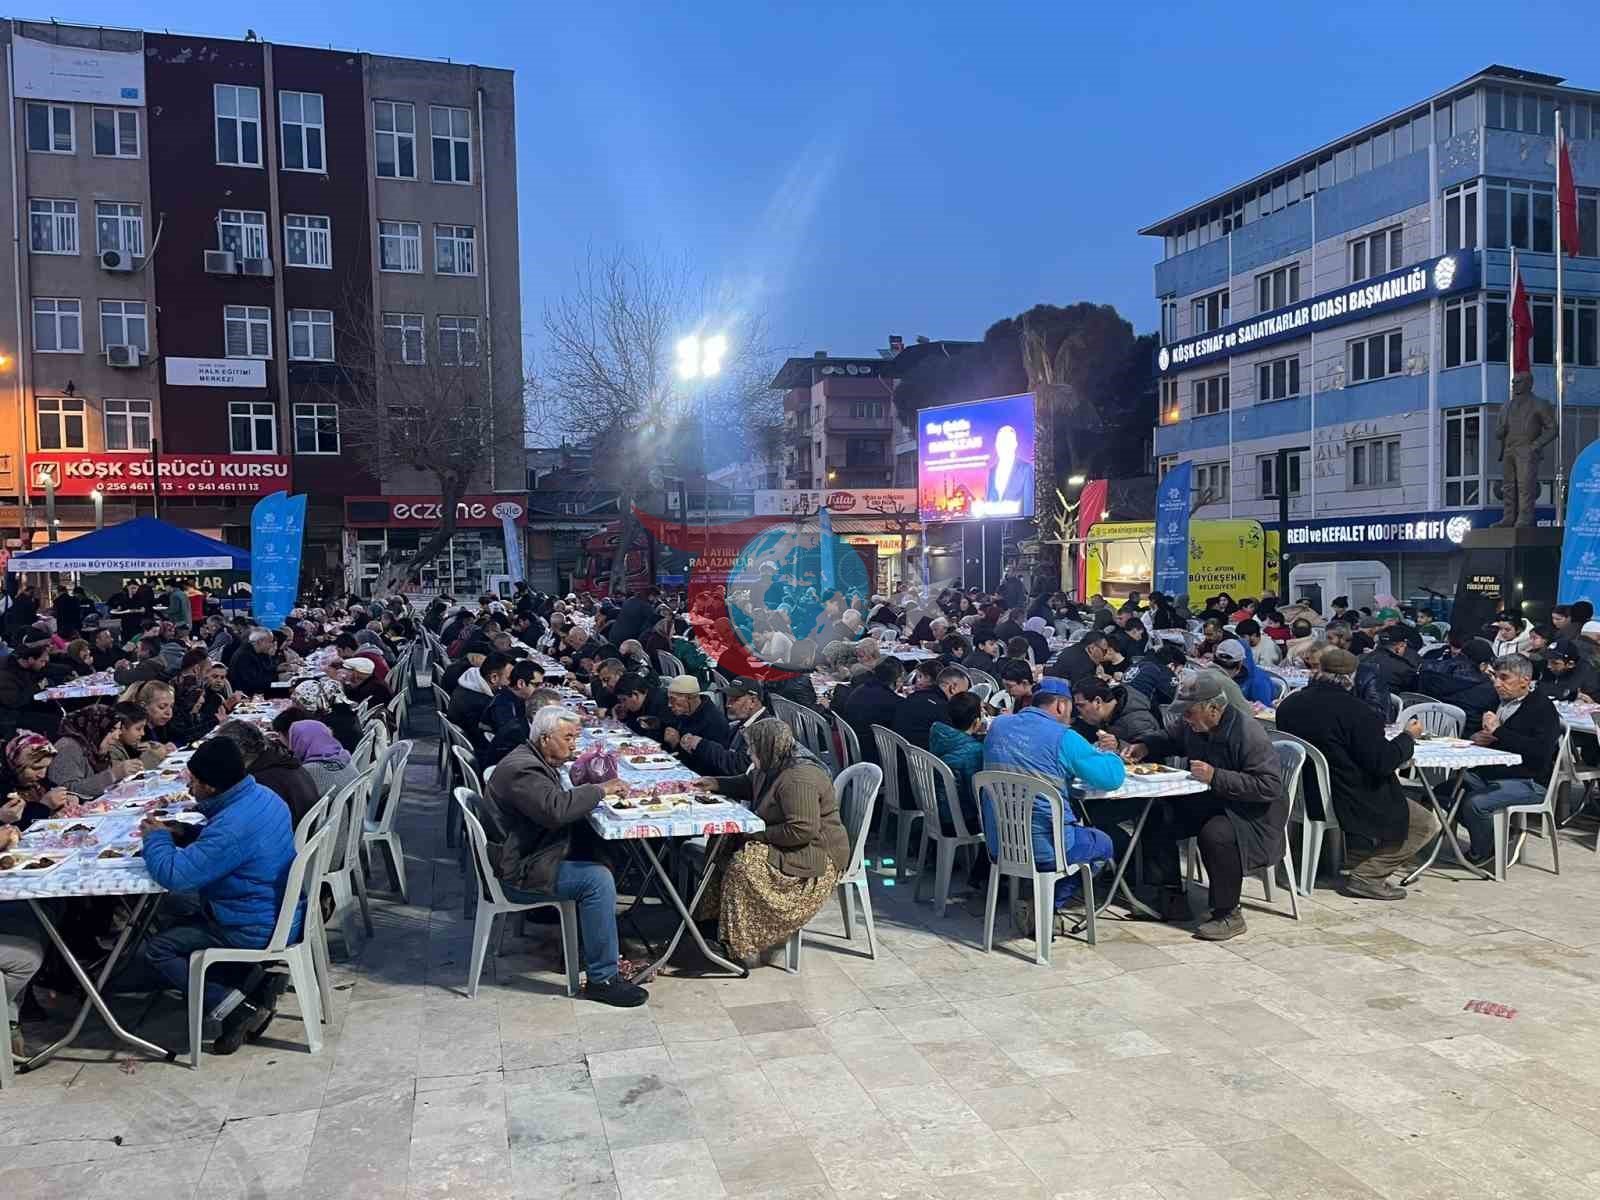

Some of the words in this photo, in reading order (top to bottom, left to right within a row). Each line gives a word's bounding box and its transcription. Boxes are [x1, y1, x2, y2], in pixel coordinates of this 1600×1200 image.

[1172, 343, 1195, 362] KÖŞK
[1196, 334, 1225, 357] ESNAF
[1225, 332, 1237, 348] ve
[1238, 306, 1309, 343] SANATKARLAR
[1311, 294, 1347, 322] ODASI
[1349, 267, 1427, 311] BAŞKANLIĞI
[64, 458, 122, 478] KÖŞK
[128, 458, 215, 477] SÜRÜCÜ
[220, 462, 288, 477] KURSU
[106, 482, 127, 491] 256
[129, 482, 148, 491] 461
[162, 482, 173, 491] 13
[198, 482, 216, 491] 541
[218, 482, 236, 491] 461
[1287, 525, 1310, 545] REDİ
[1322, 524, 1366, 543] KEFALET
